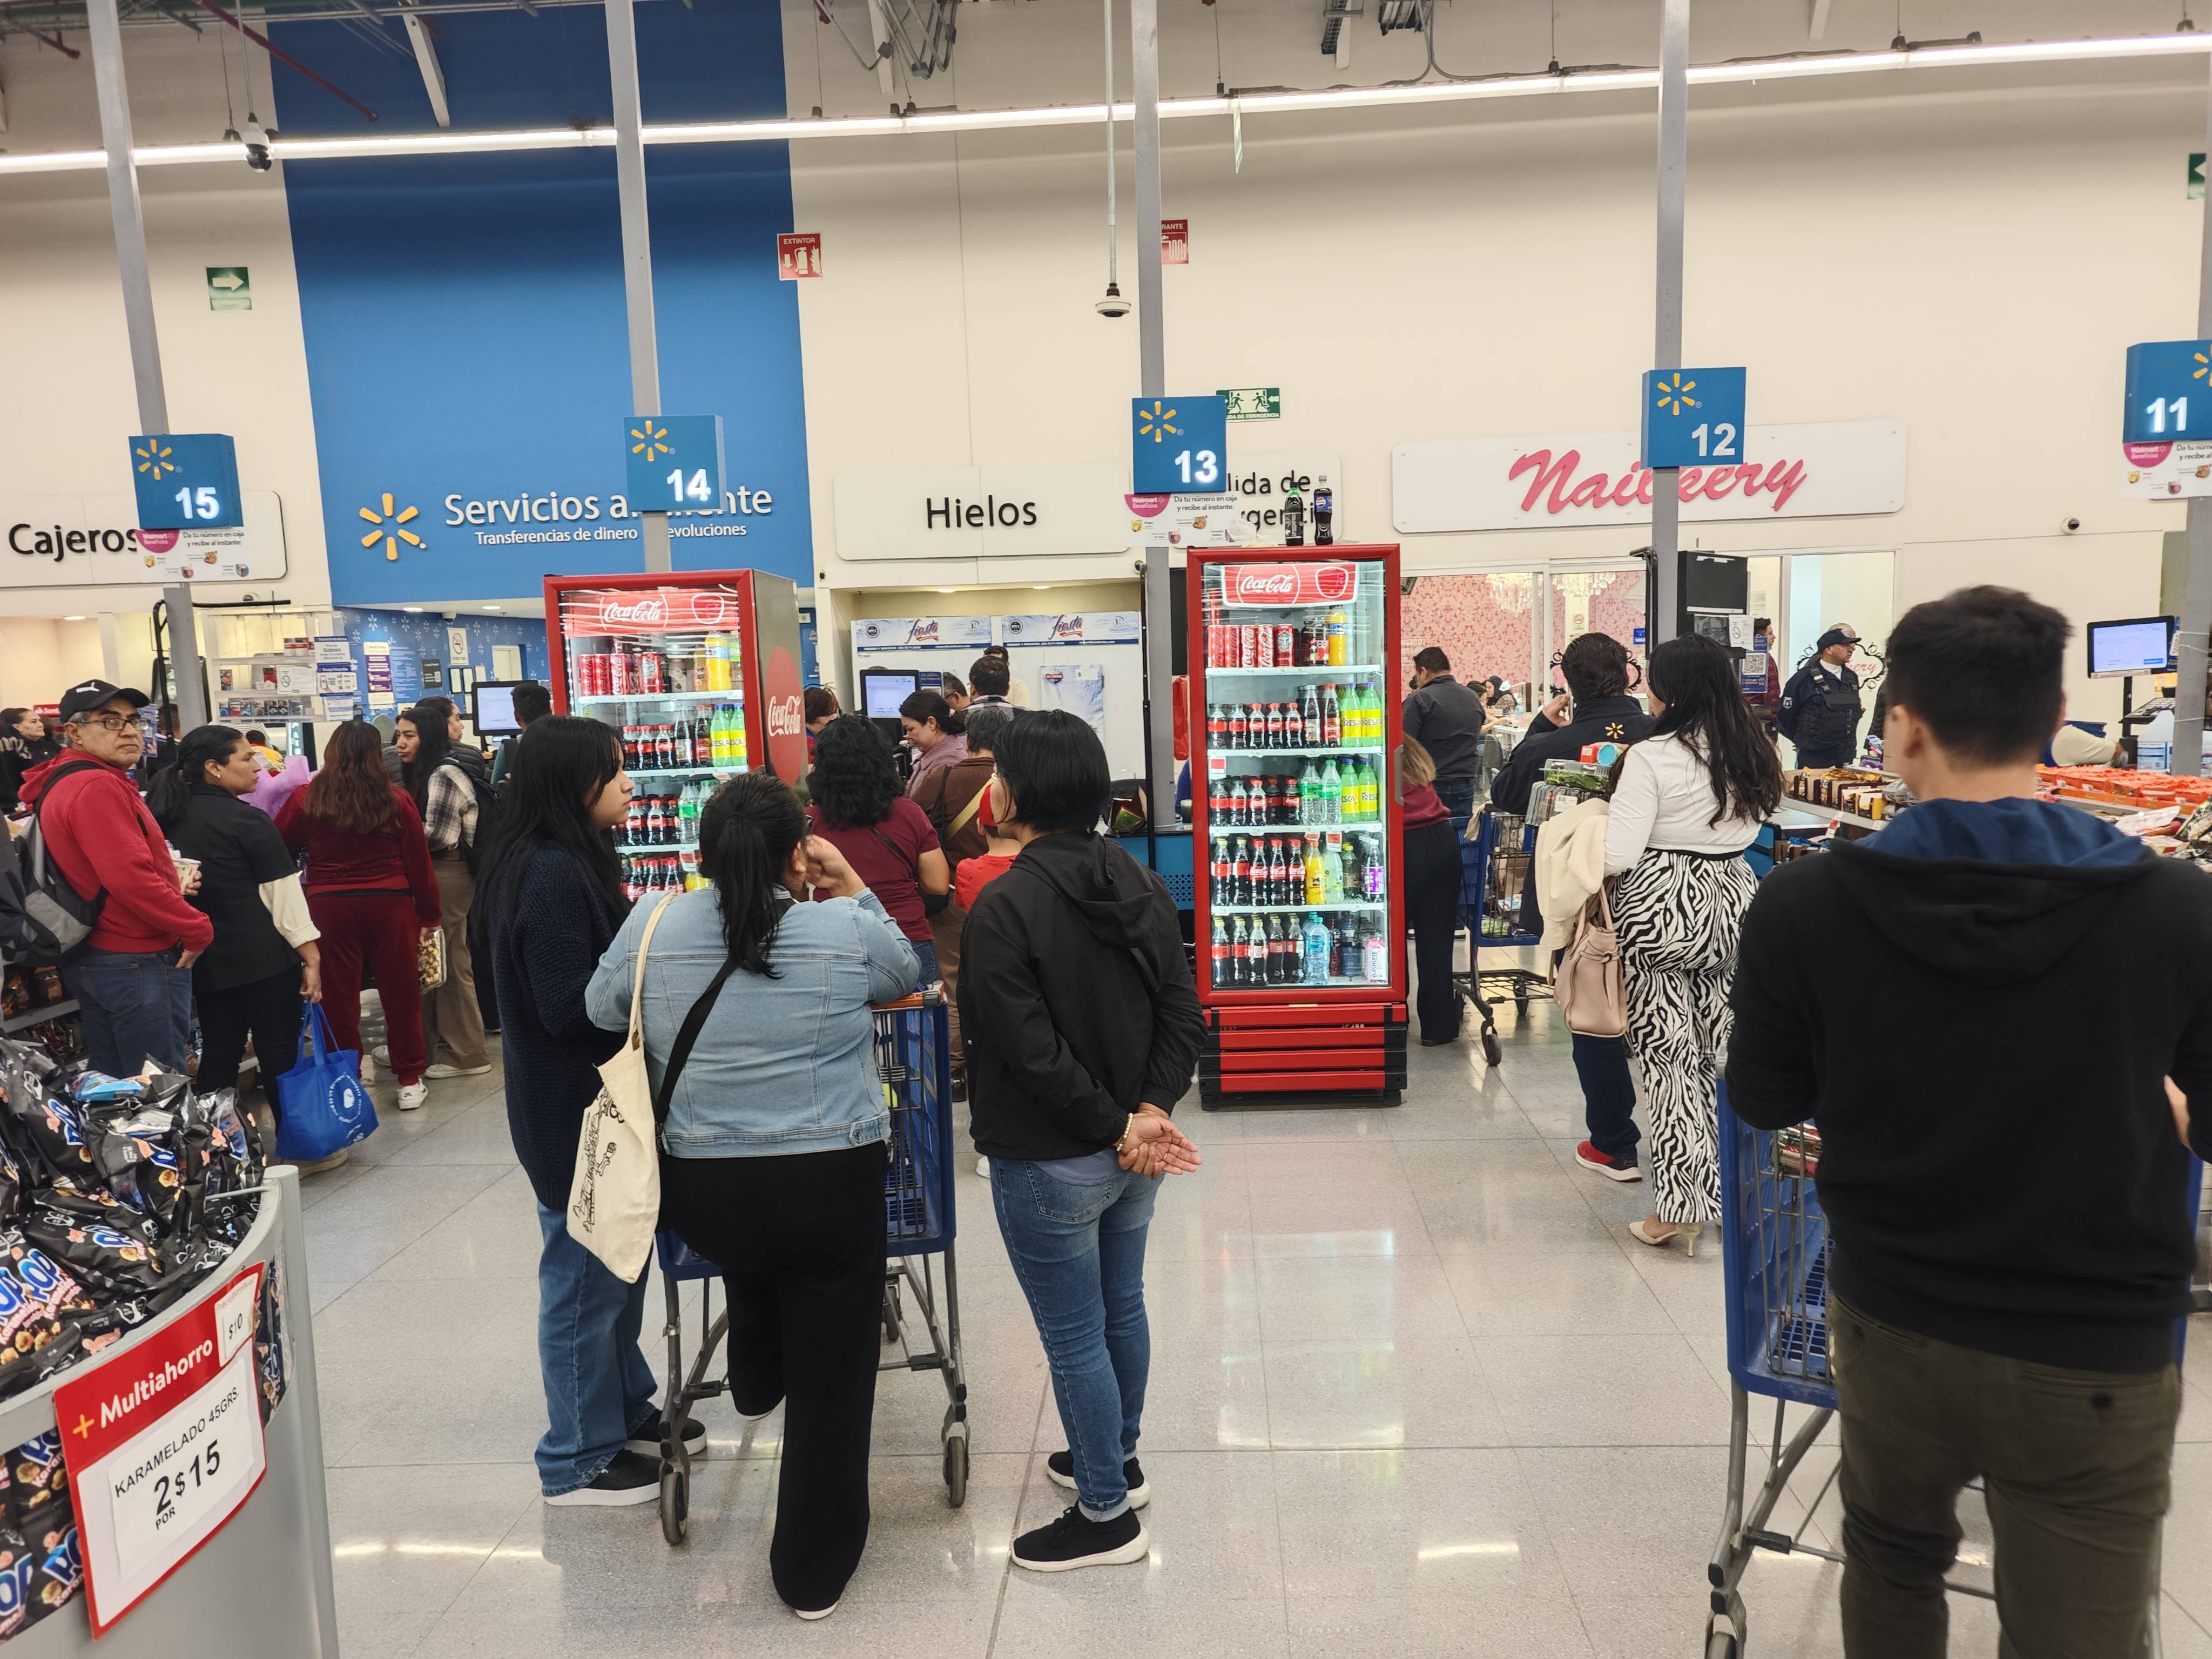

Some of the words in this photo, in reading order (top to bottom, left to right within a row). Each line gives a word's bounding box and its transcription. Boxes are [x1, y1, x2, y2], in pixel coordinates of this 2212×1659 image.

[2147, 397, 2188, 433] 11
[1691, 423, 1736, 457] 12
[1175, 450, 1218, 483] 13
[667, 469, 712, 502] 14
[176, 487, 219, 520] 15
[444, 491, 600, 525] Servicios
[927, 495, 1037, 529] Hielos
[475, 530, 571, 545] Transferencias
[574, 528, 591, 541] de
[594, 527, 638, 540] dinero
[905, 619, 939, 644] fiesta
[1048, 615, 1083, 640] fiesta
[229, 1313, 242, 1340] $10
[101, 1339, 213, 1428] Multiahorro
[115, 1418, 205, 1498] KARAMELADO
[208, 1387, 239, 1422] 45GRS.
[156, 1507, 176, 1530] POR
